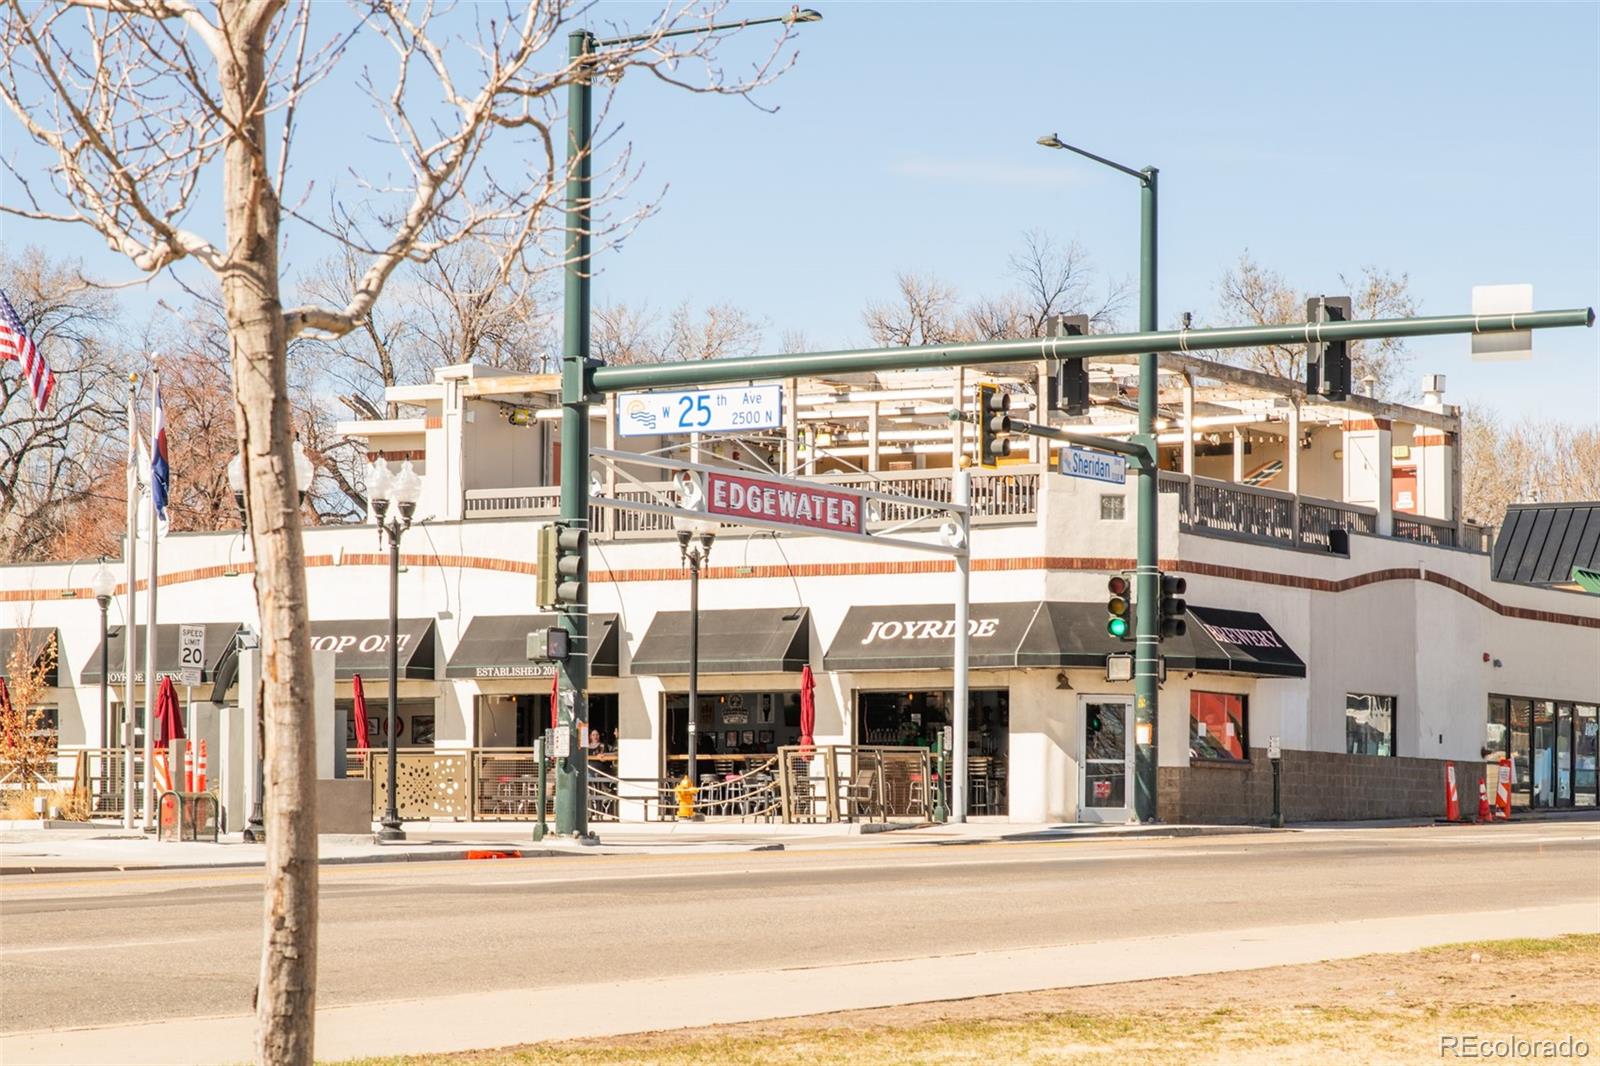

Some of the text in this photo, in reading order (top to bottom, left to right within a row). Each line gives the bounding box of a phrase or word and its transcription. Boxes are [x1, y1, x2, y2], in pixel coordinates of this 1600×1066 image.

[662, 406, 671, 418] W
[742, 392, 762, 405] Ave
[732, 410, 773, 425] 2500 N
[1072, 452, 1111, 478] Sheridan
[713, 479, 856, 527] EDGEWATER
[182, 629, 203, 638] SPEED
[184, 638, 201, 646] LIMIT
[1203, 623, 1283, 648] BREWERY
[182, 647, 202, 664] 20
[476, 666, 559, 677] ESTABLISHED 201
